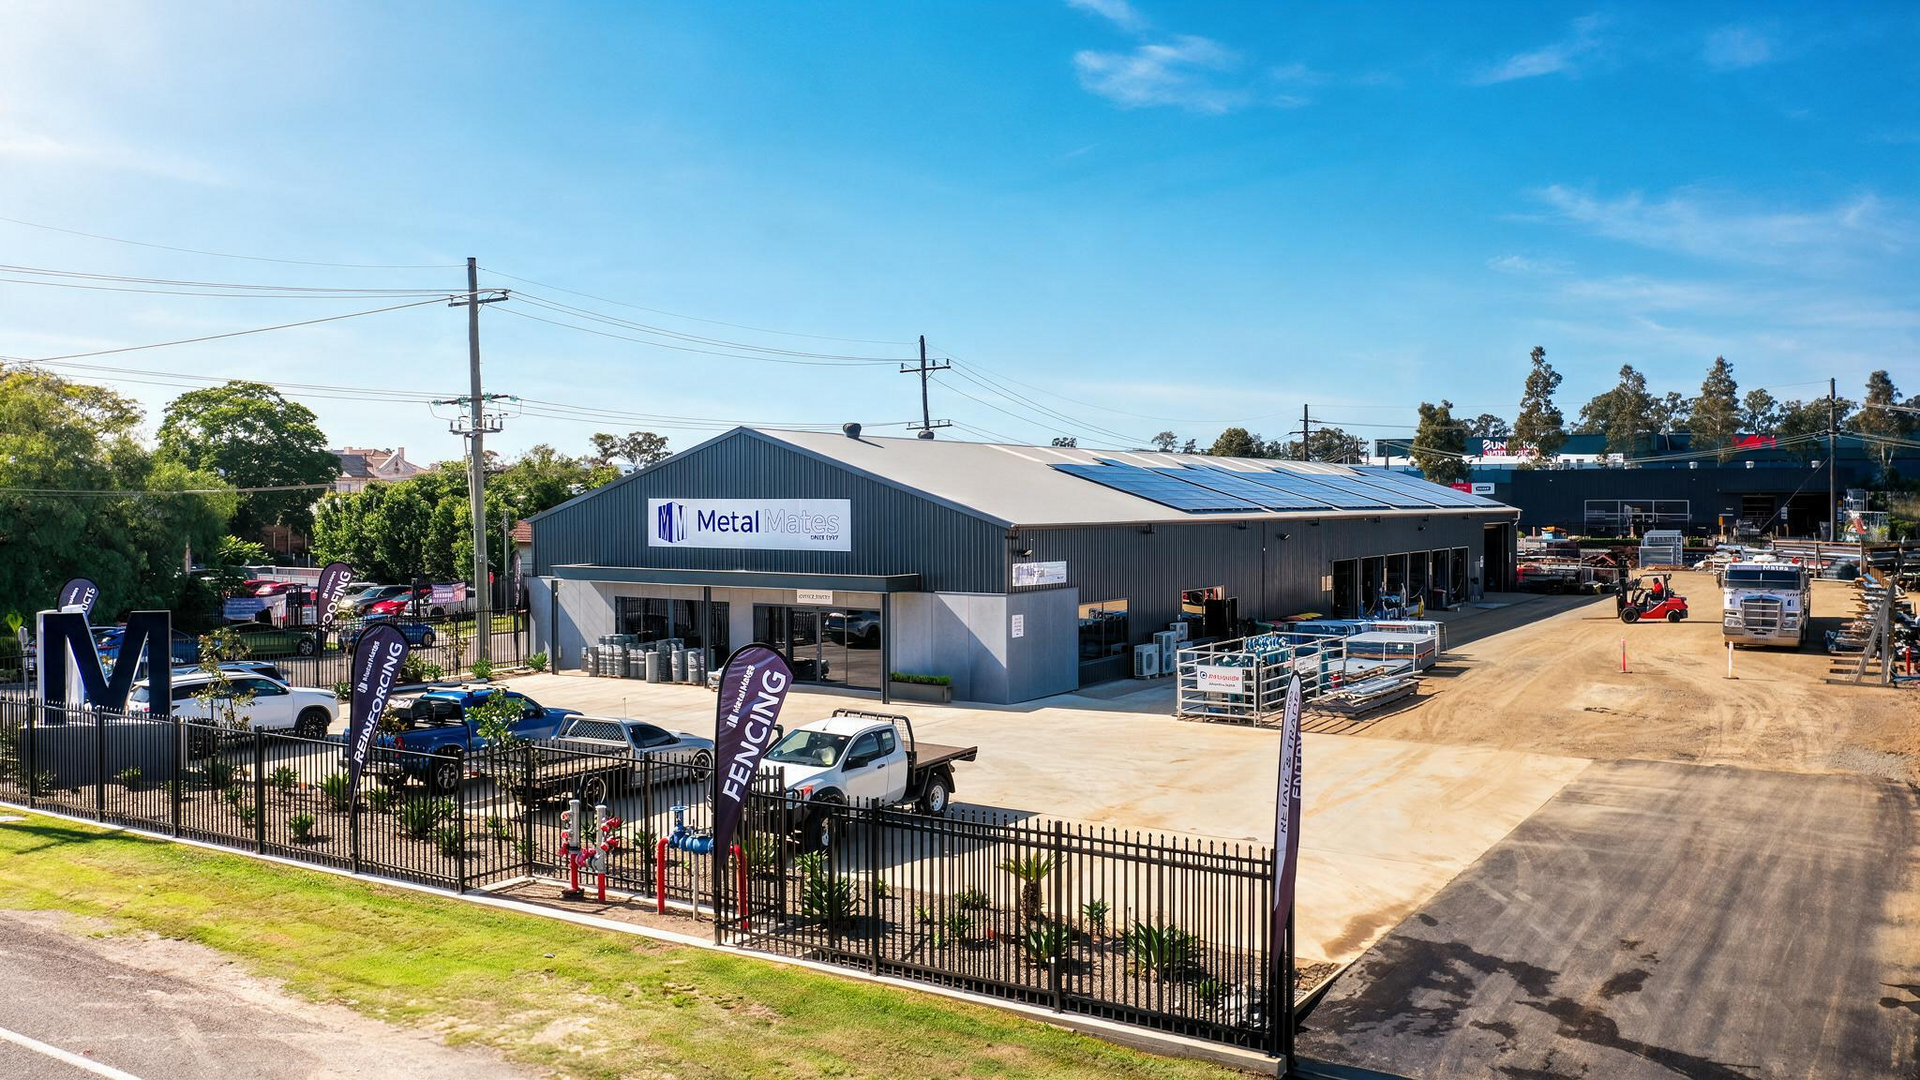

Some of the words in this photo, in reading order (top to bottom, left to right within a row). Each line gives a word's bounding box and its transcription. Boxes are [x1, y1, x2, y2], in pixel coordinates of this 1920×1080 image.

[698, 510, 759, 533] Metal
[764, 509, 840, 534] Mates
[321, 571, 351, 626] OOFING
[353, 641, 403, 764] REINFORCING
[733, 688, 747, 714] Metal
[741, 664, 756, 694] Mates
[722, 669, 787, 803] FENCING
[1281, 774, 1290, 833] RETAIL
[1286, 691, 1299, 750] TRADE
